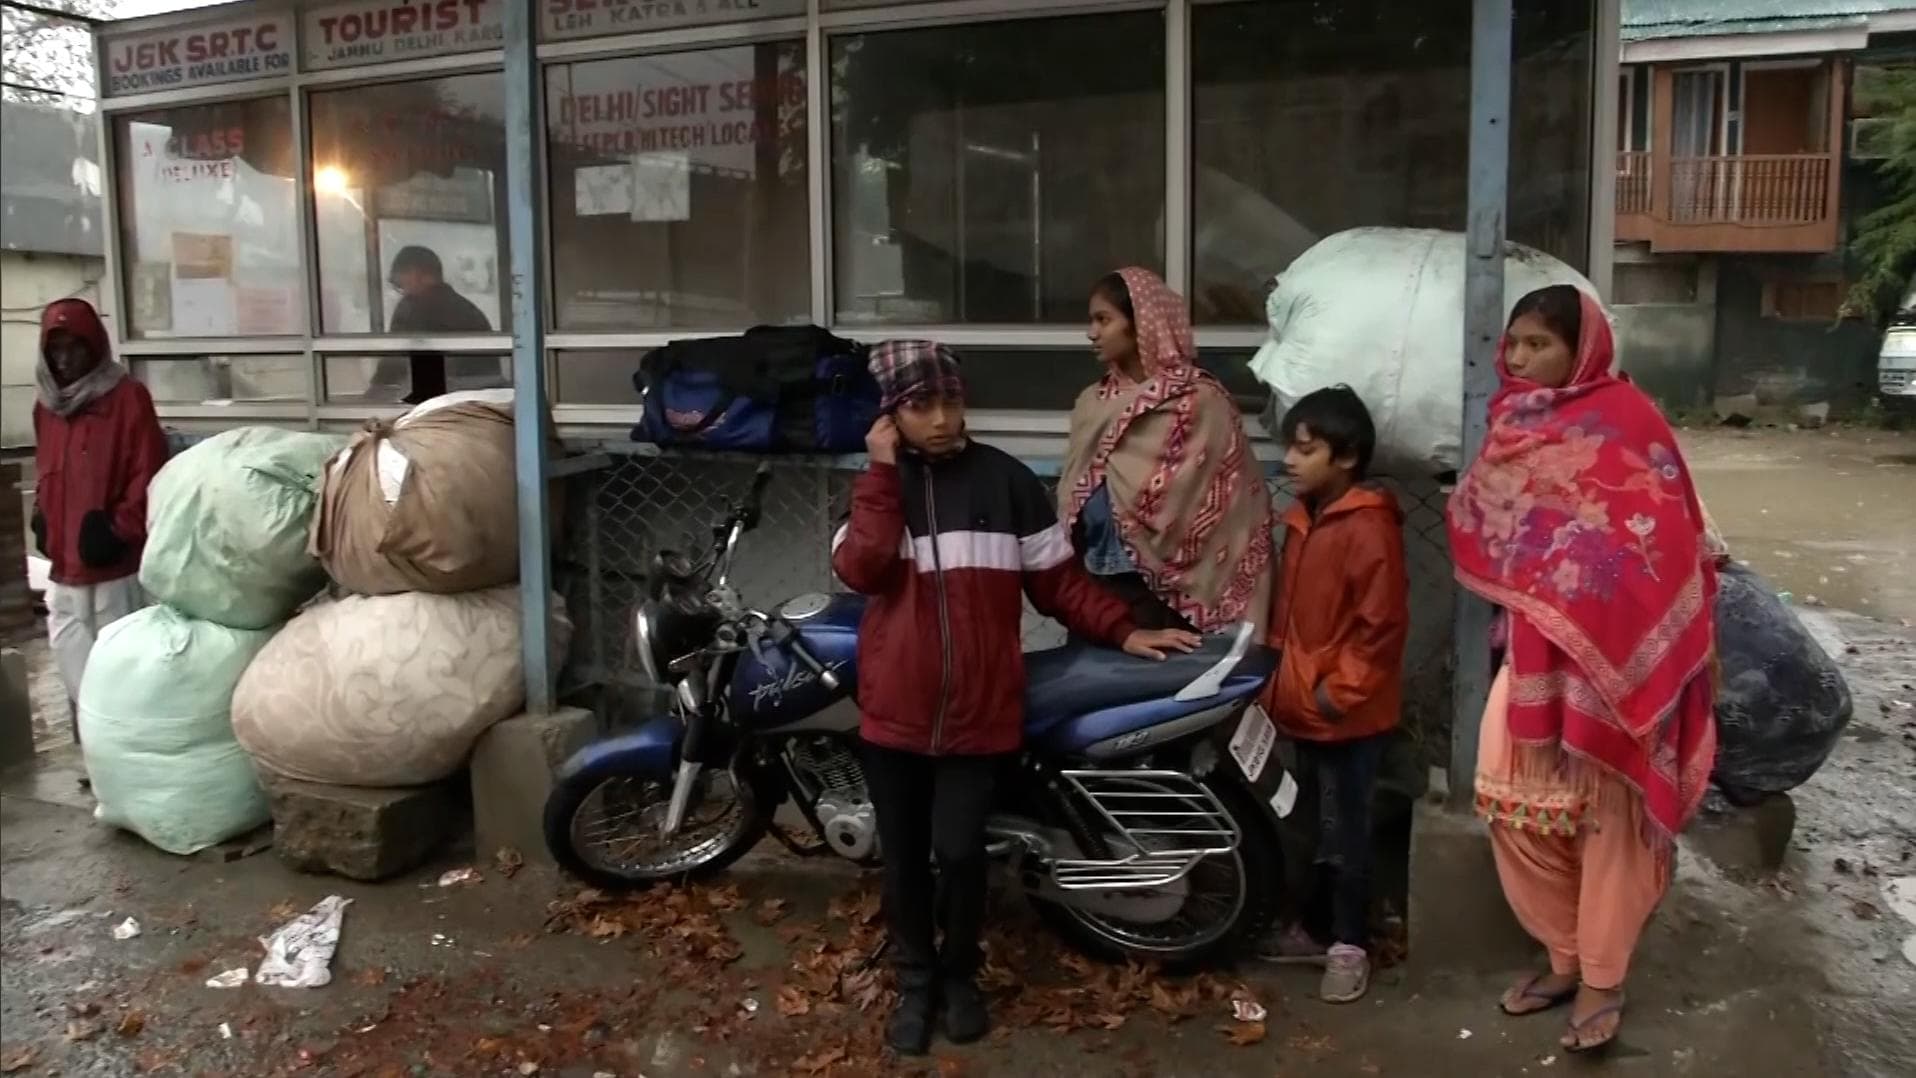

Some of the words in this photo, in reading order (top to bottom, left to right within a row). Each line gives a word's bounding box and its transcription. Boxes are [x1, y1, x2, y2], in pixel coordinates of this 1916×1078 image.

[318, 0, 487, 45] TOURIST
[553, 13, 593, 32] LEH
[394, 32, 444, 53] DELHI
[111, 67, 183, 92] BOOKINGS
[188, 53, 260, 80] AVAILABLE
[264, 52, 290, 70] FOR
